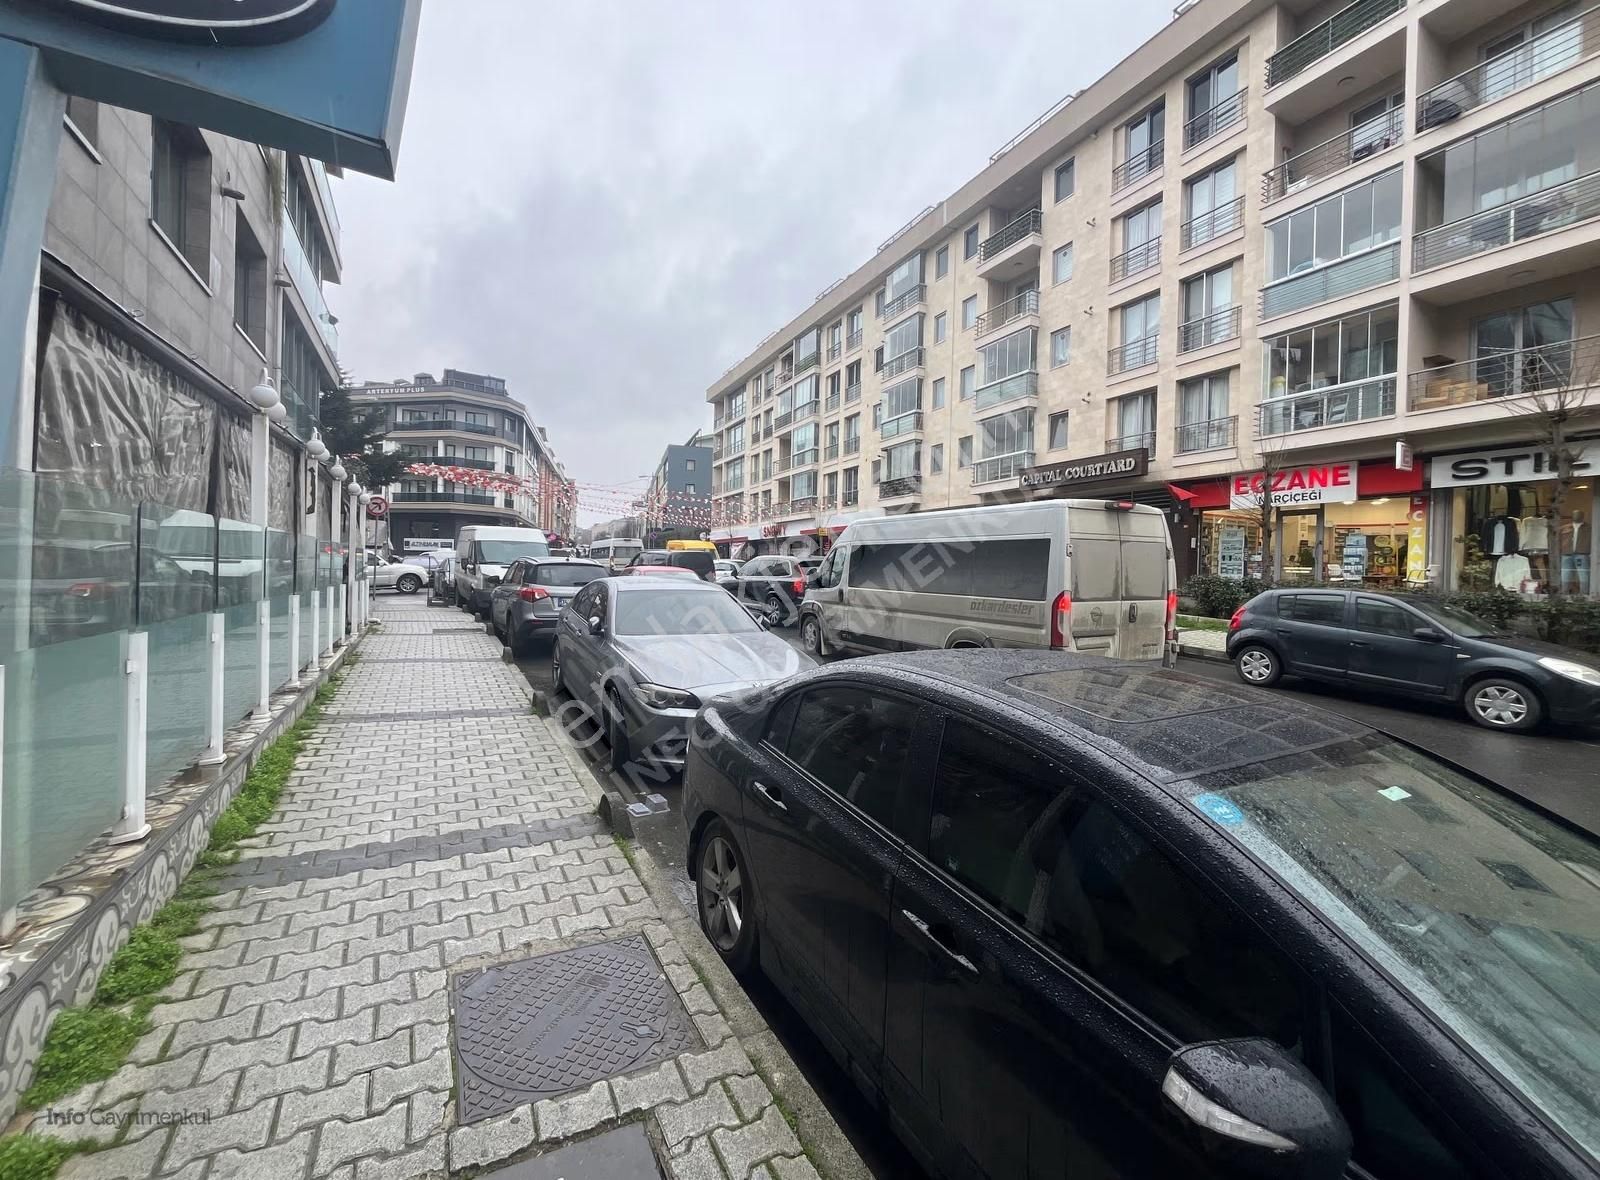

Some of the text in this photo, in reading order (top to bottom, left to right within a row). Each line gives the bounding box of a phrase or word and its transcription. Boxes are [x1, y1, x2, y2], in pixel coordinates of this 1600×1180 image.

[1021, 457, 1137, 486] CAPITAL COURTYARD
[1234, 464, 1351, 495] ECZANE
[1258, 489, 1322, 504] NRÇİÇEĞİ
